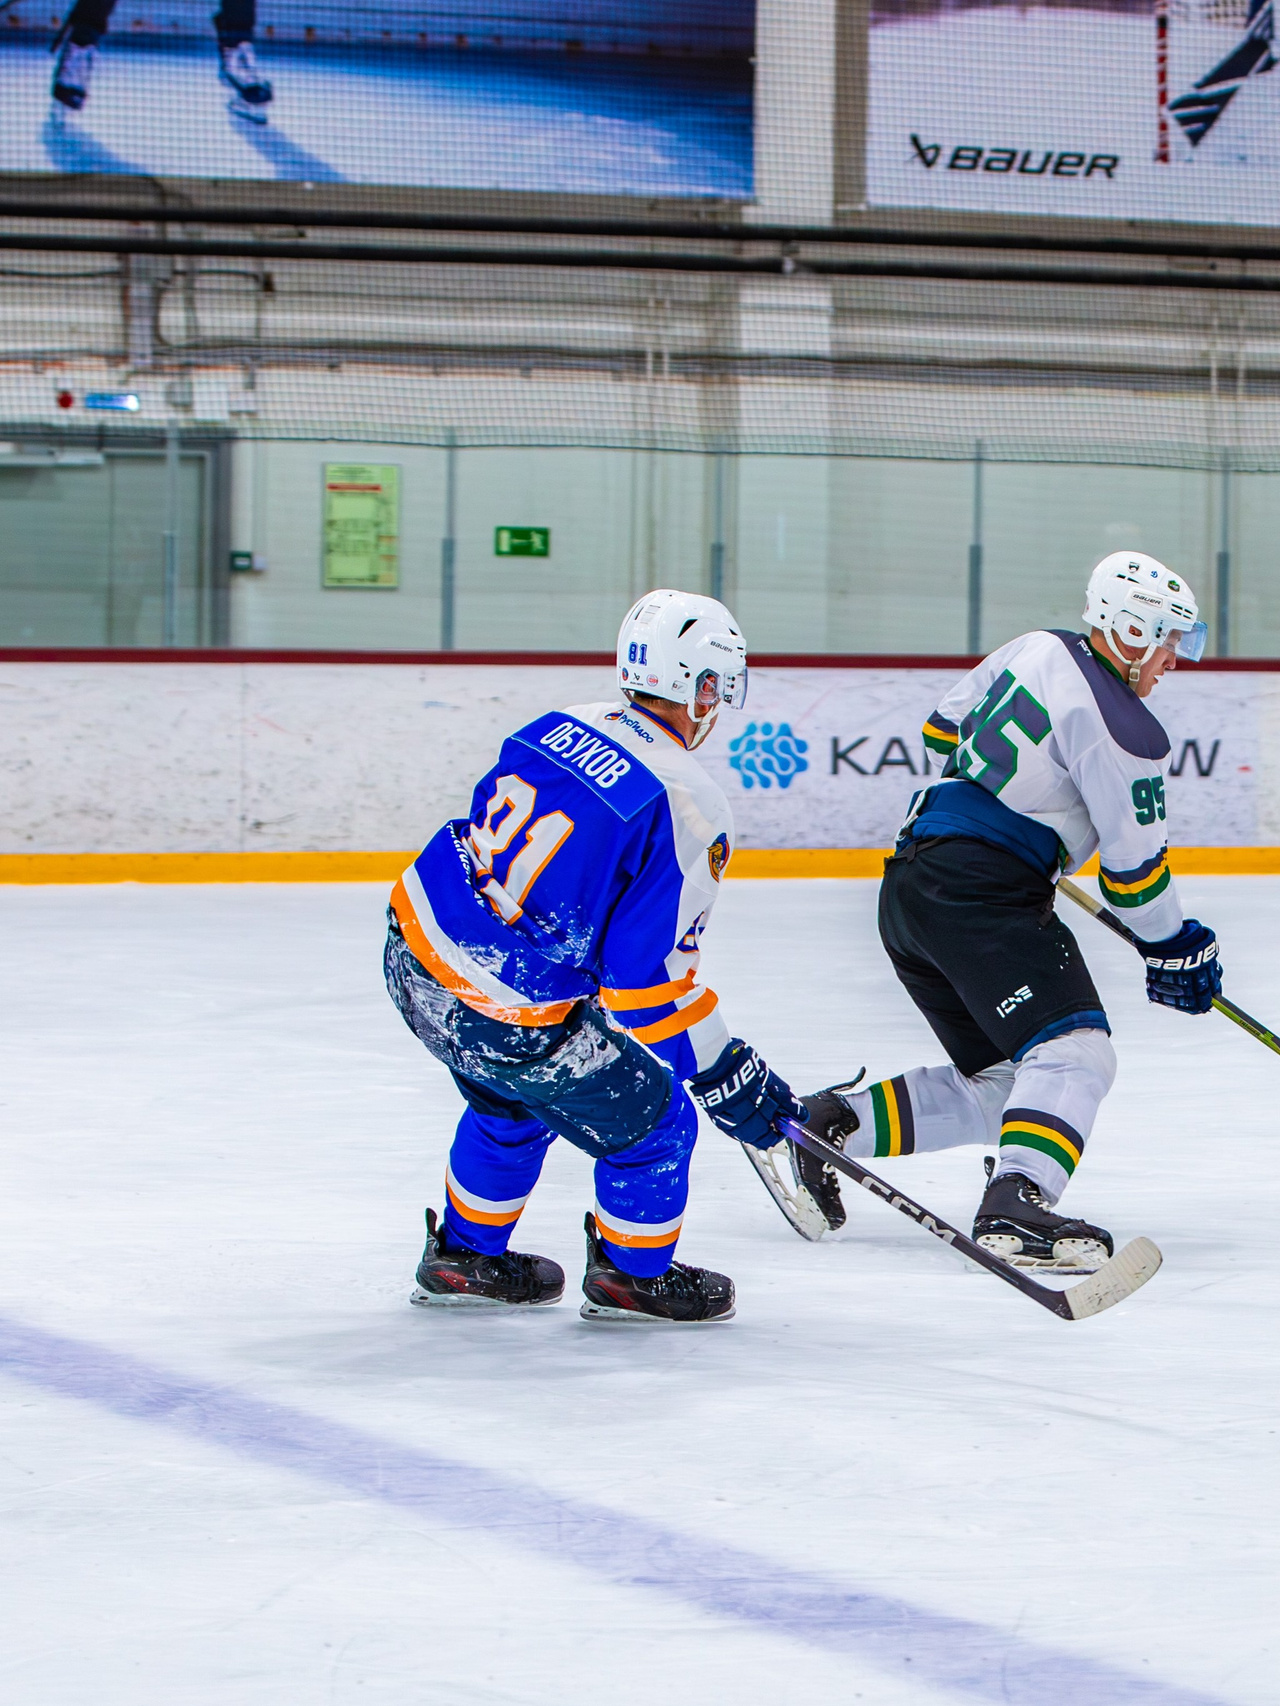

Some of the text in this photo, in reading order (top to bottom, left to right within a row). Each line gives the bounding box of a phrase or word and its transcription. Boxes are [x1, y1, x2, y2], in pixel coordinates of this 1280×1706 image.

[947, 144, 1120, 178] BAUER
[1132, 593, 1162, 606] BAUER
[628, 641, 648, 667] 81
[710, 640, 733, 654] BAUER
[540, 721, 632, 789] ОБУХОВ
[1131, 774, 1166, 826] 95
[1145, 941, 1217, 970] BAUE
[860, 1175, 957, 1245] CCM
